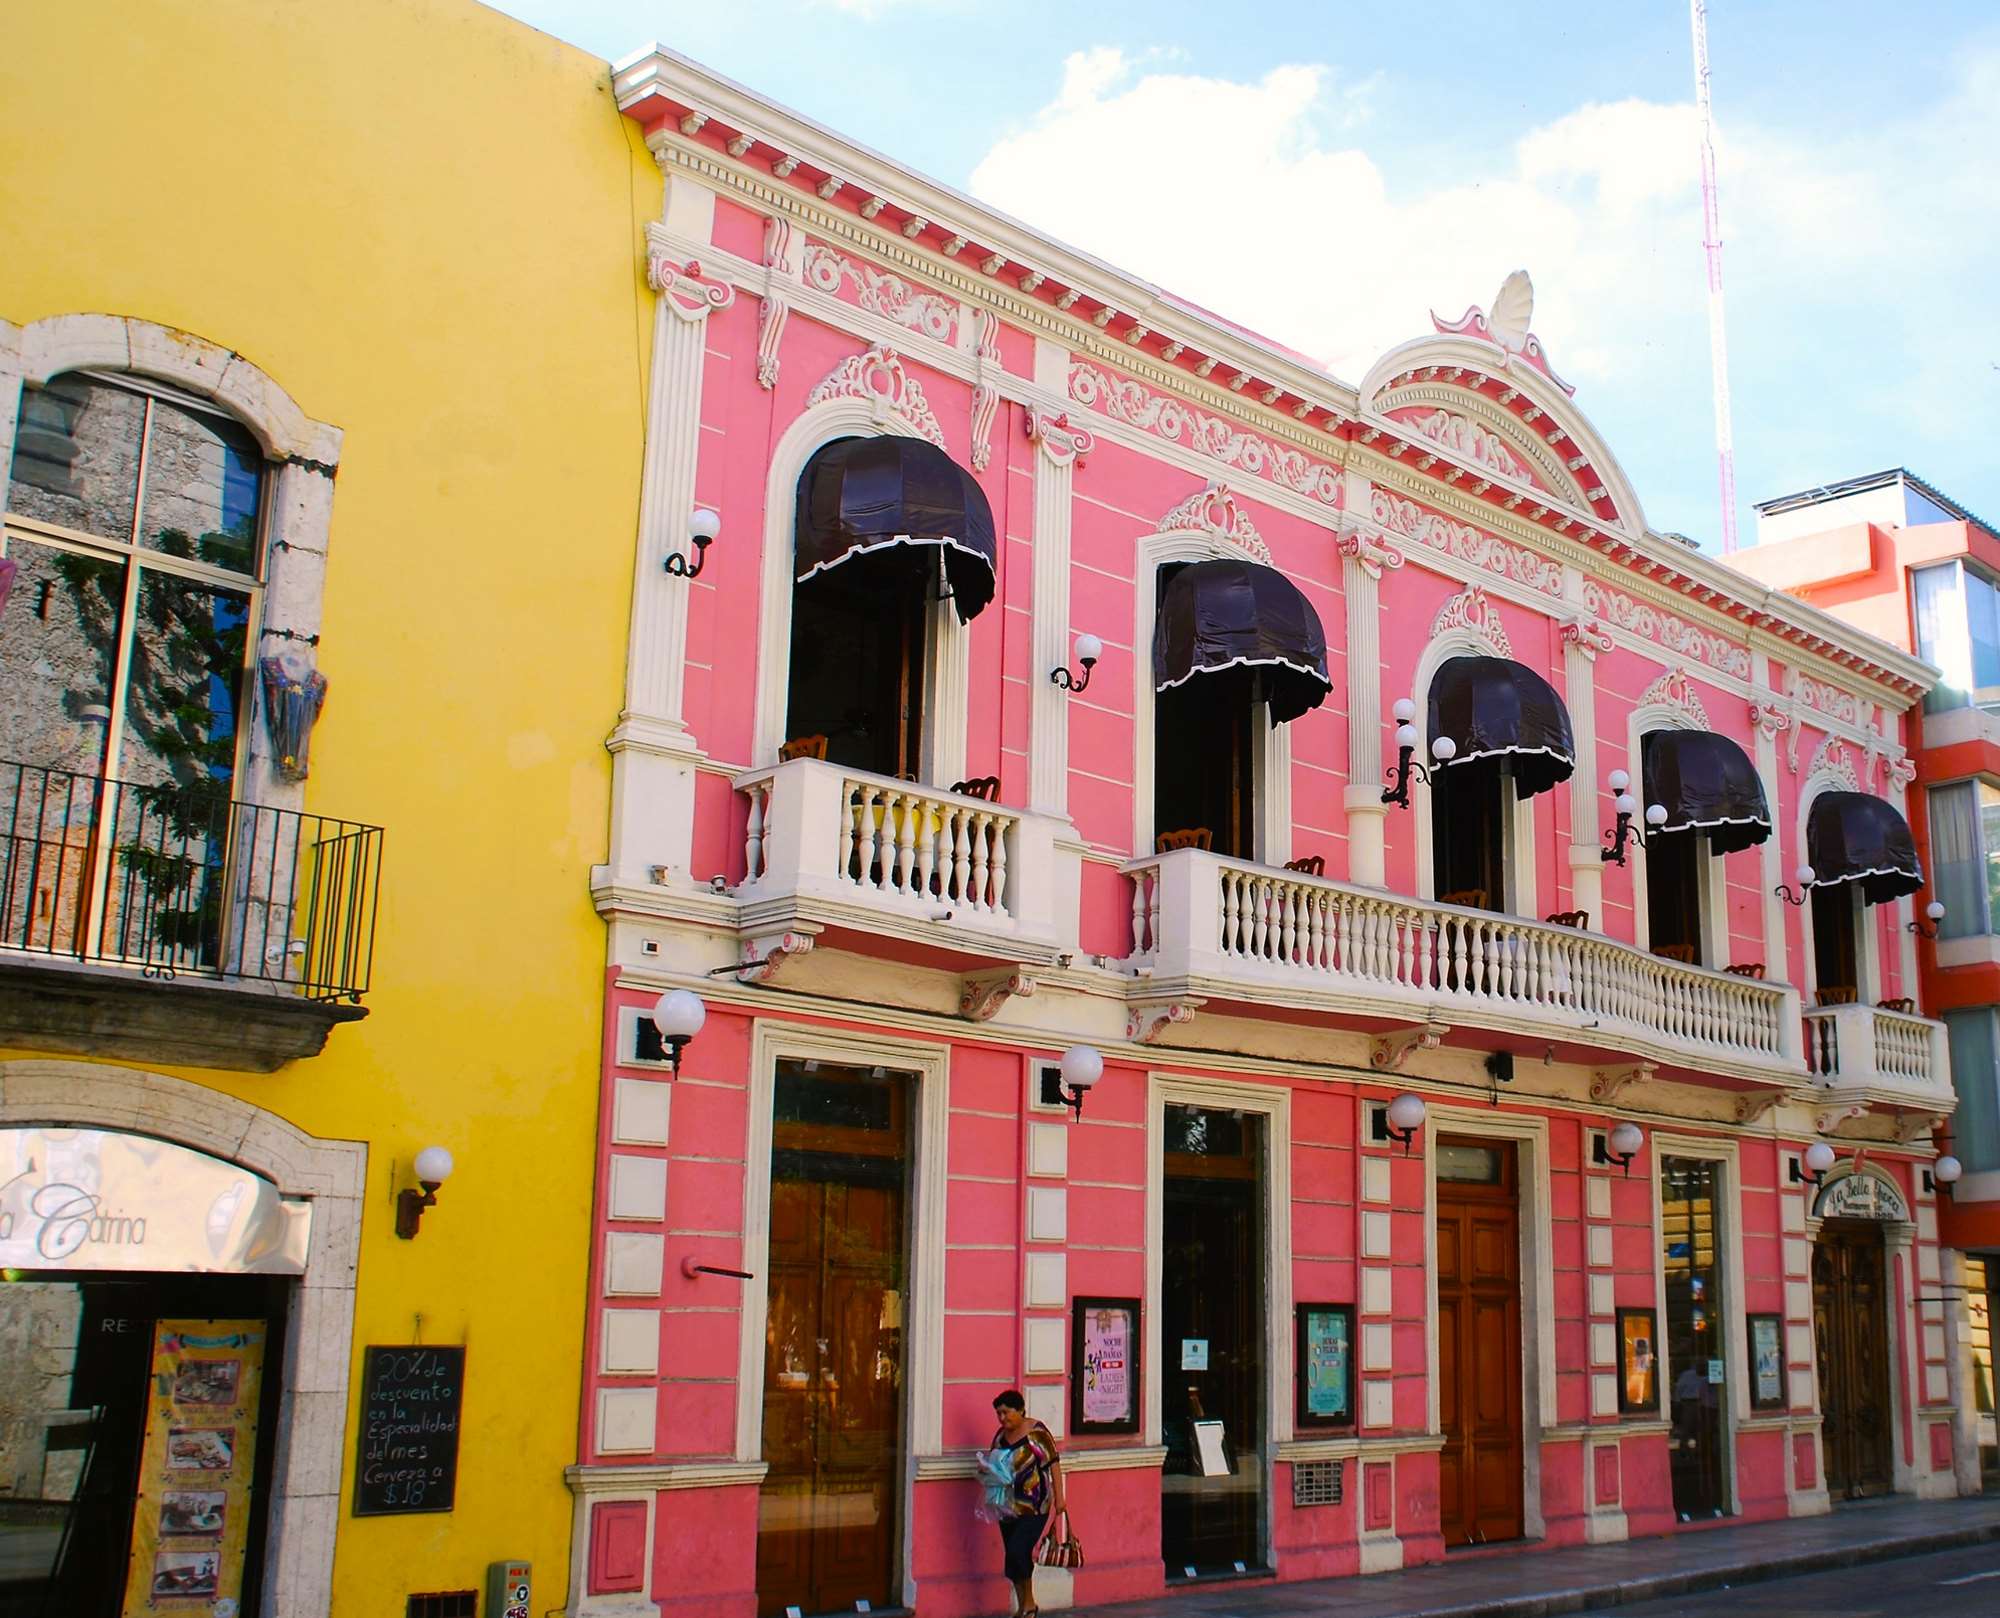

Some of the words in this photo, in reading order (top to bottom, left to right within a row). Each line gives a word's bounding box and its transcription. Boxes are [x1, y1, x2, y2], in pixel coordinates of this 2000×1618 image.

[1845, 1176, 1869, 1198] Belle
[31, 1183, 146, 1260] Catrina
[1103, 1338, 1121, 1346] NOCHE
[377, 1351, 426, 1382] 20%
[424, 1355, 447, 1378] de
[370, 1382, 453, 1402] descuento
[1102, 1384, 1123, 1394] NIGHT
[368, 1410, 386, 1420] en
[392, 1402, 407, 1420] la
[366, 1440, 389, 1460] del
[391, 1445, 428, 1460] mes
[364, 1463, 427, 1485] Cerveza
